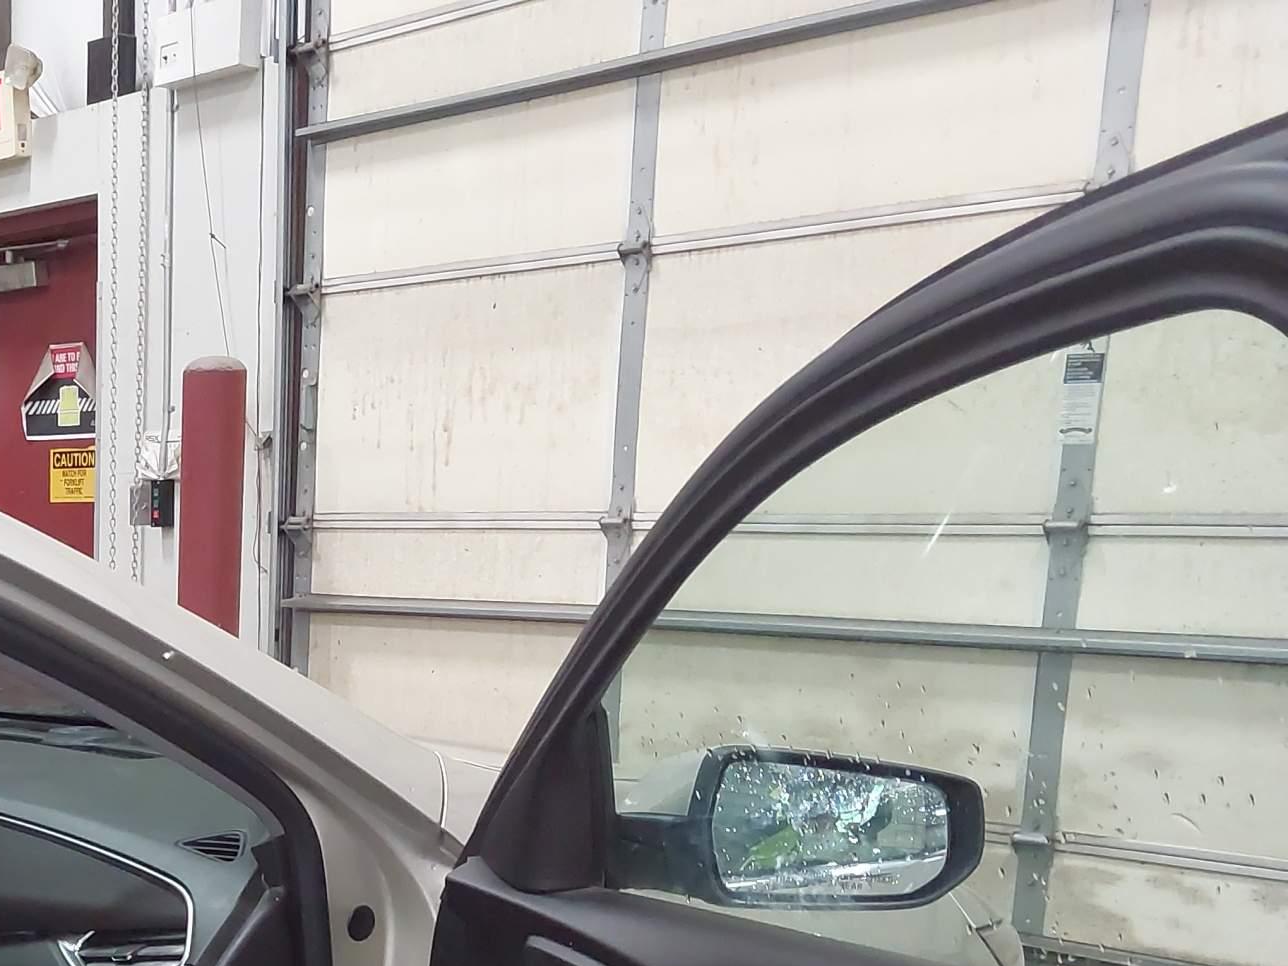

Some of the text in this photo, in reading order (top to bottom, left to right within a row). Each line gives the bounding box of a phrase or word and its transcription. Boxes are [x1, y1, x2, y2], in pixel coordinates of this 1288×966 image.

[55, 352, 67, 363] ARE
[68, 351, 76, 361] TO
[54, 452, 95, 467] CAUTION
